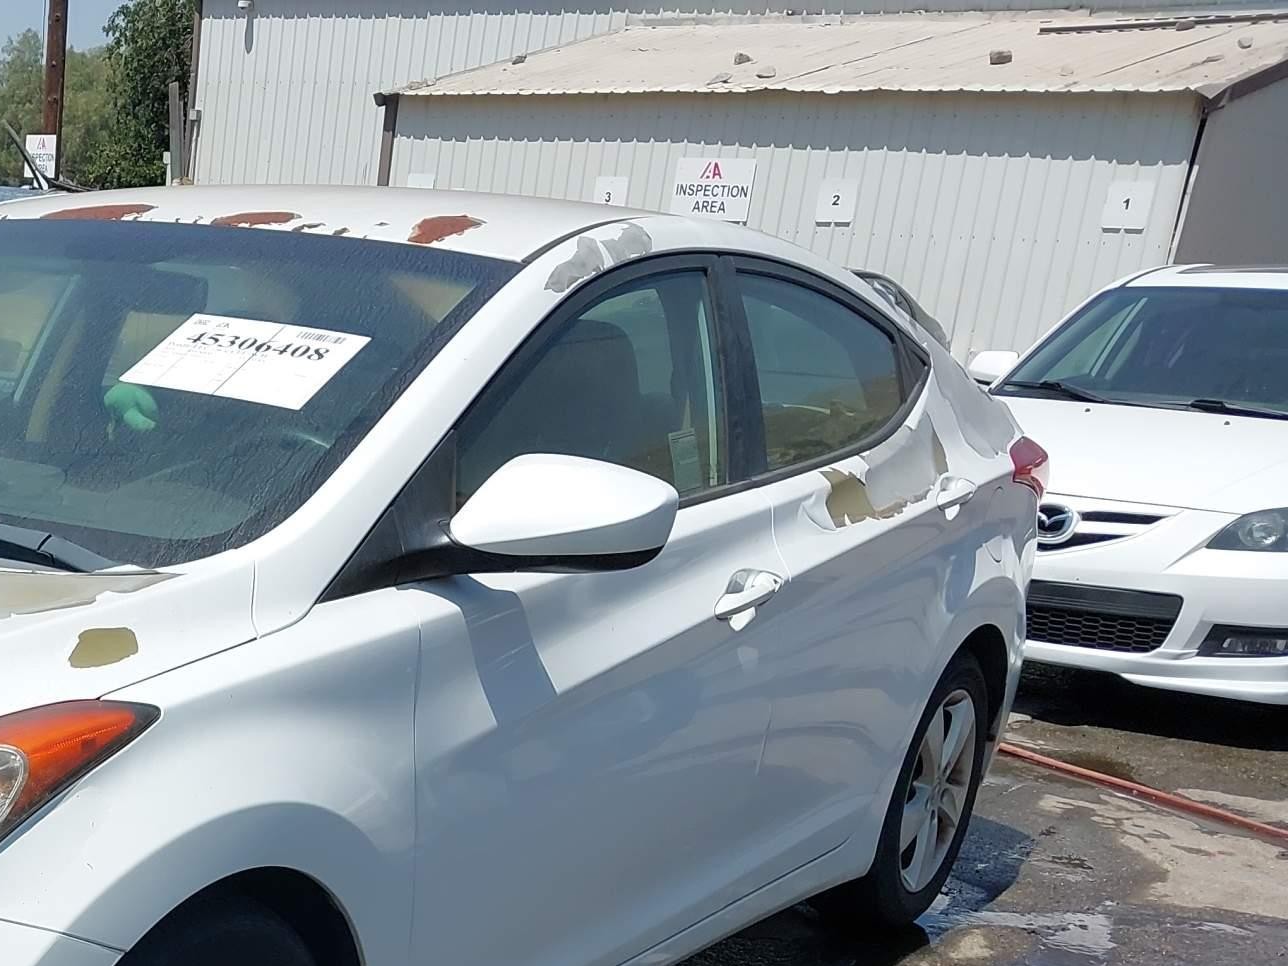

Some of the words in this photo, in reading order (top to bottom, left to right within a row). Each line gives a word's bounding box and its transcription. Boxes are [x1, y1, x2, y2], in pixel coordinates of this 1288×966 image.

[604, 191, 612, 203] 3
[675, 183, 749, 198] INSPECTION
[831, 194, 841, 206] 2
[1122, 197, 1131, 210] 1
[691, 200, 726, 214] AREA
[186, 331, 330, 361] 45306408
